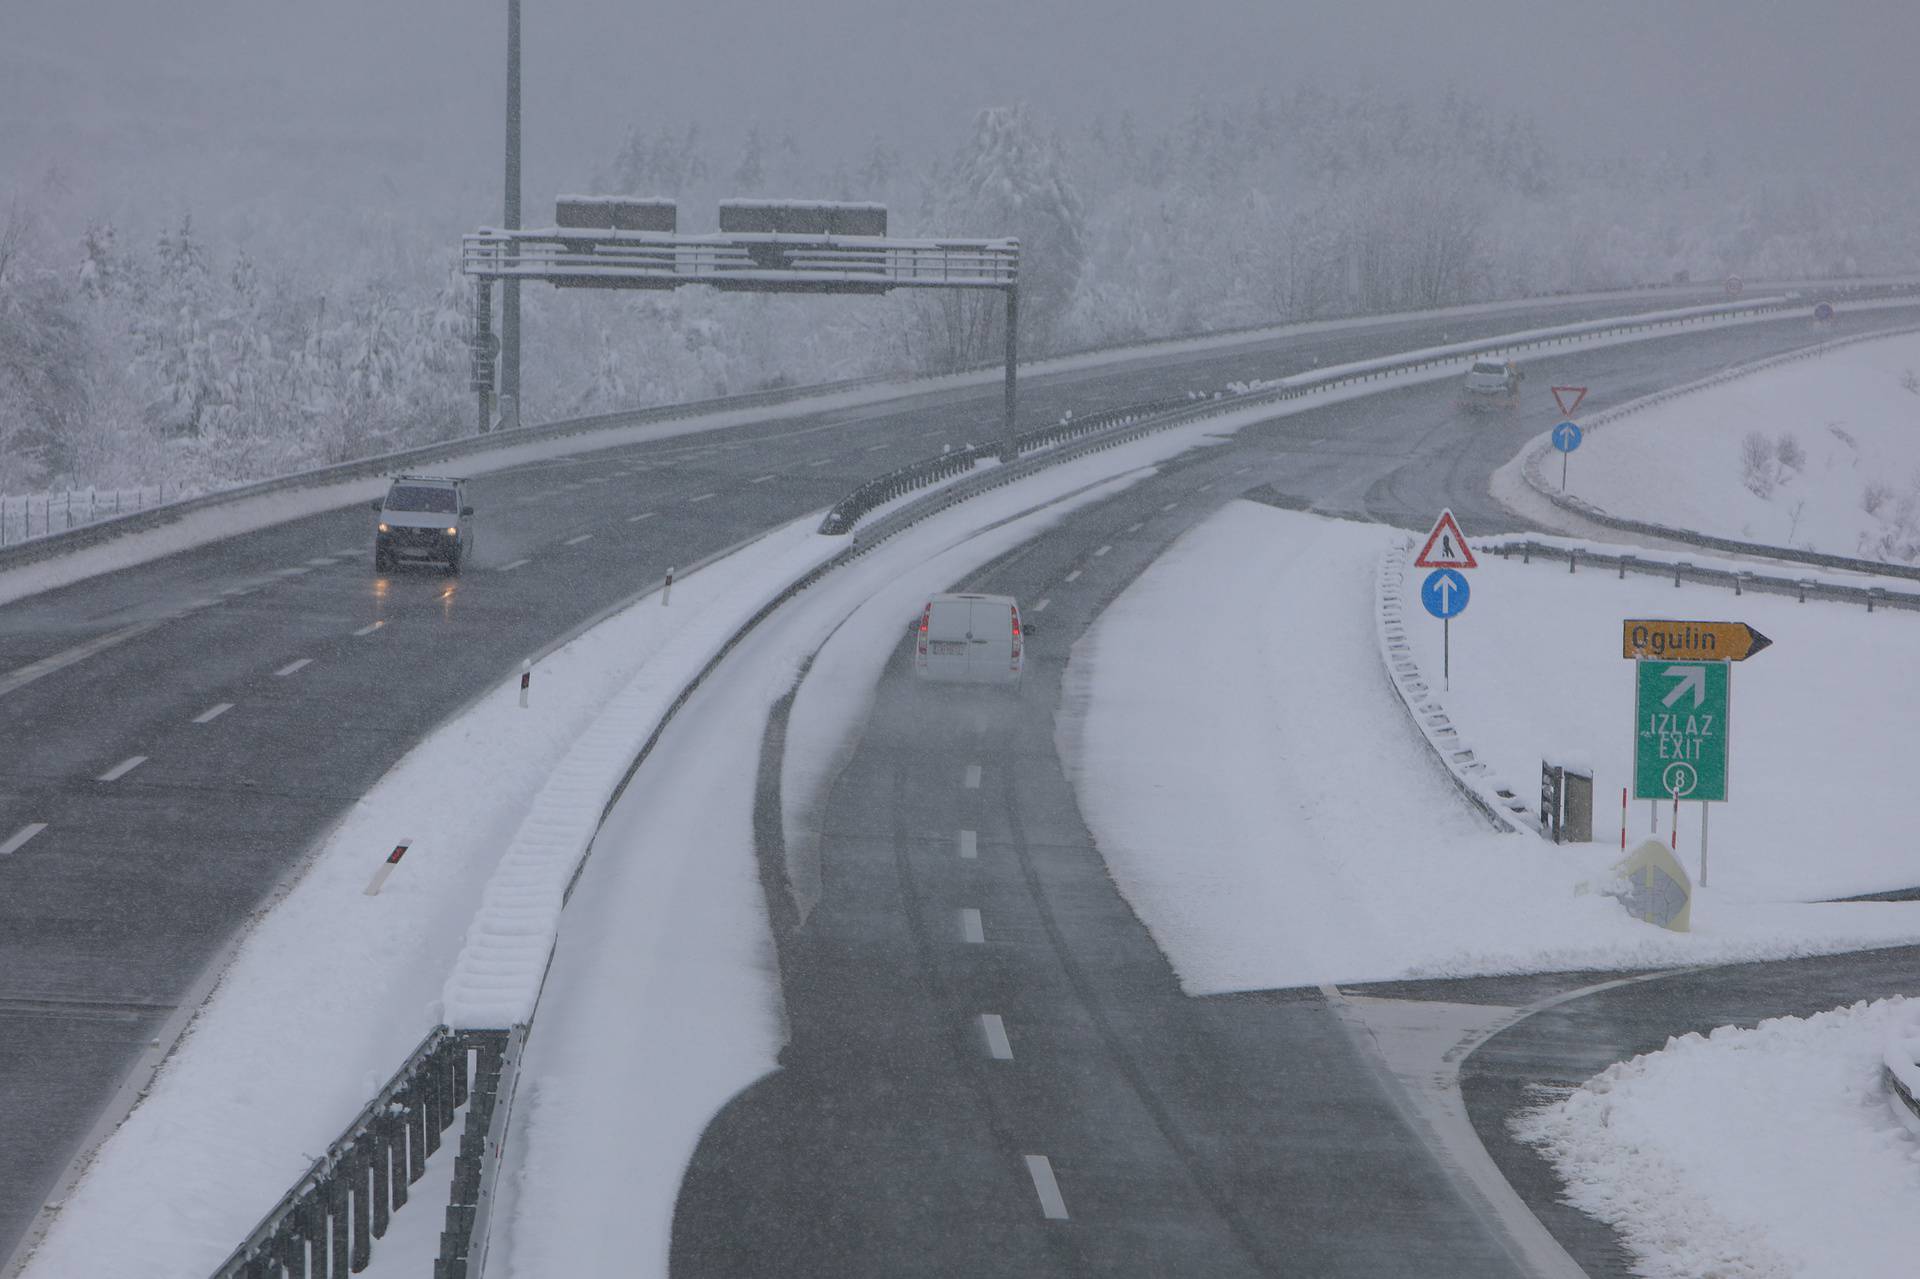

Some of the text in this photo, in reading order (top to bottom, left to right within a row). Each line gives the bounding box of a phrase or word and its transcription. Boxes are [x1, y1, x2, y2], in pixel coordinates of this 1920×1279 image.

[1632, 626, 1716, 654] Ogulin
[1651, 714, 1712, 735] IZLAZ
[1660, 738, 1703, 759] EXIT
[1675, 770, 1685, 787] 8
